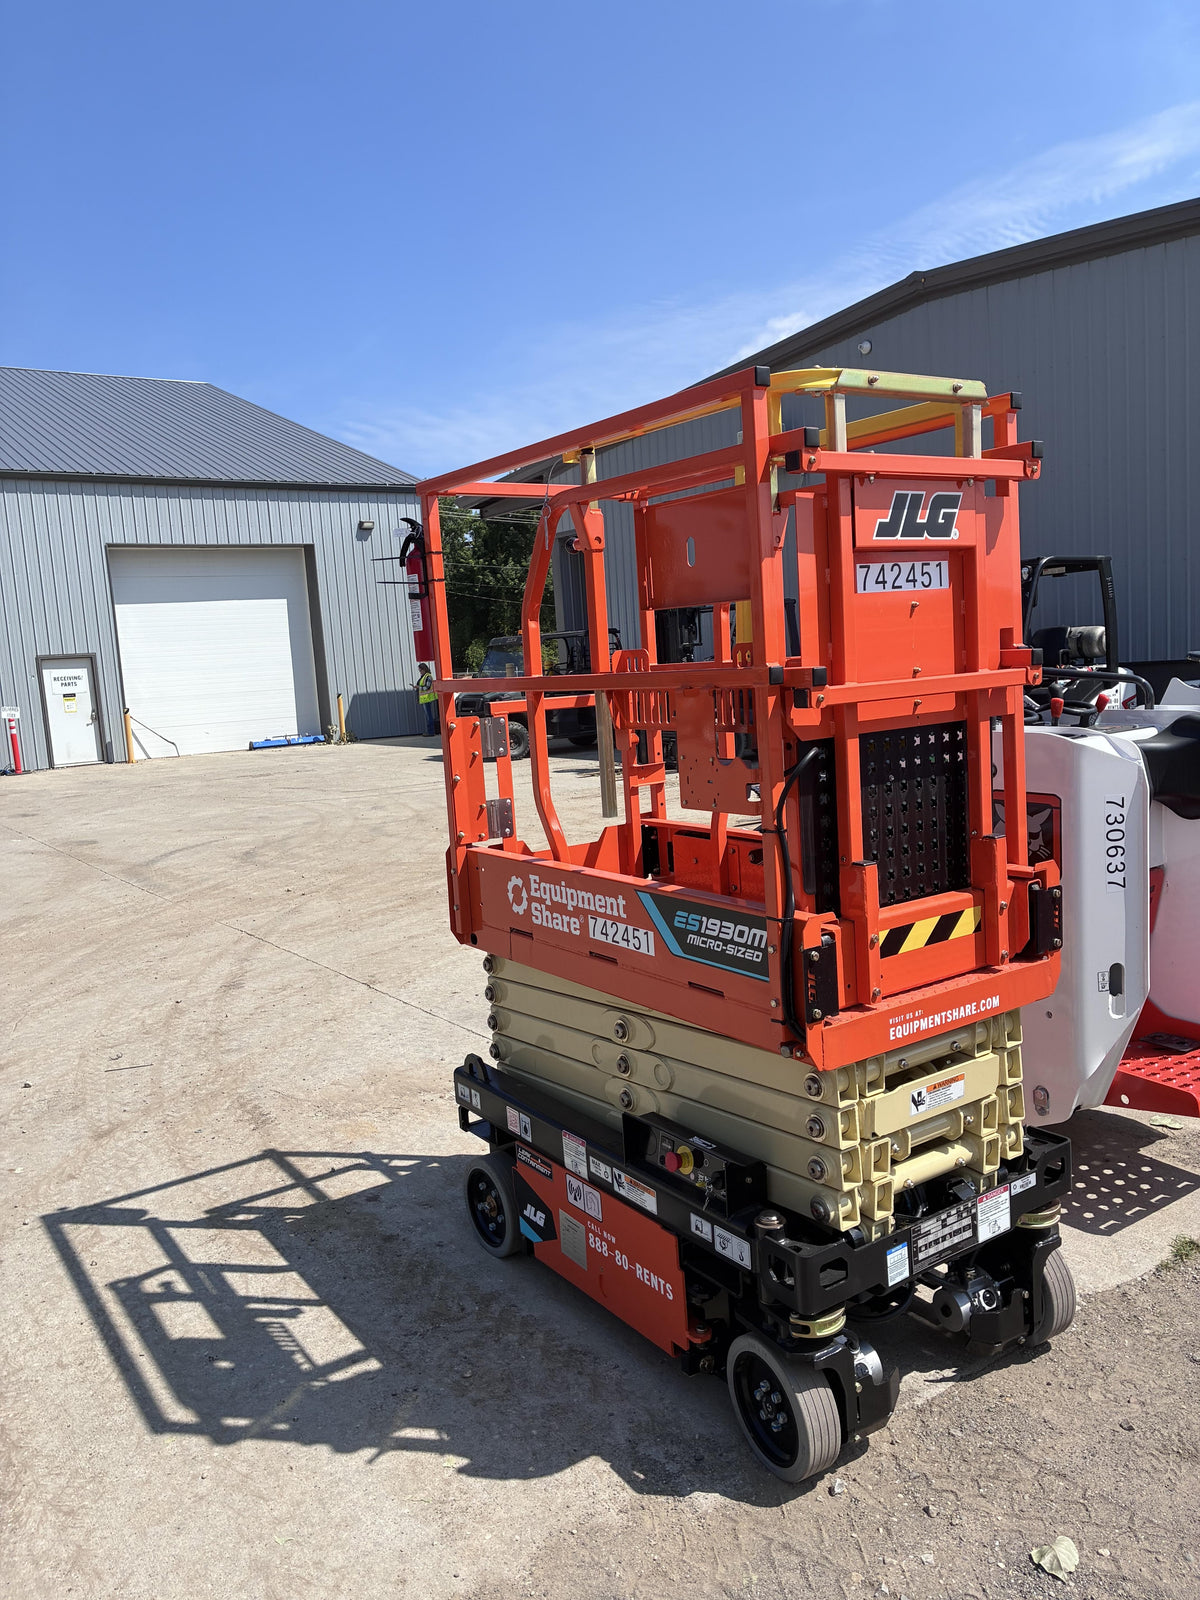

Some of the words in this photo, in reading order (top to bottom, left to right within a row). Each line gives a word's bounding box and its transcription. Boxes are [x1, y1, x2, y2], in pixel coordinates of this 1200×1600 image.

[873, 490, 963, 540] JLG
[859, 562, 943, 591] 742451
[1105, 796, 1126, 889] 730637
[529, 874, 627, 919] Equipment
[531, 901, 580, 936] Share
[590, 916, 651, 953] 742451
[674, 910, 768, 949] ES1930M
[687, 933, 763, 962] MICRO-SIZED
[889, 995, 1000, 1041] EQUIPMENTSHARE.COM
[889, 1015, 904, 1025] VISIT
[906, 1012, 913, 1020] US
[523, 1203, 546, 1228] JLG
[587, 1220, 601, 1235] CALL
[603, 1230, 617, 1244] NOW
[588, 1233, 674, 1301] 888-80-RENTS
